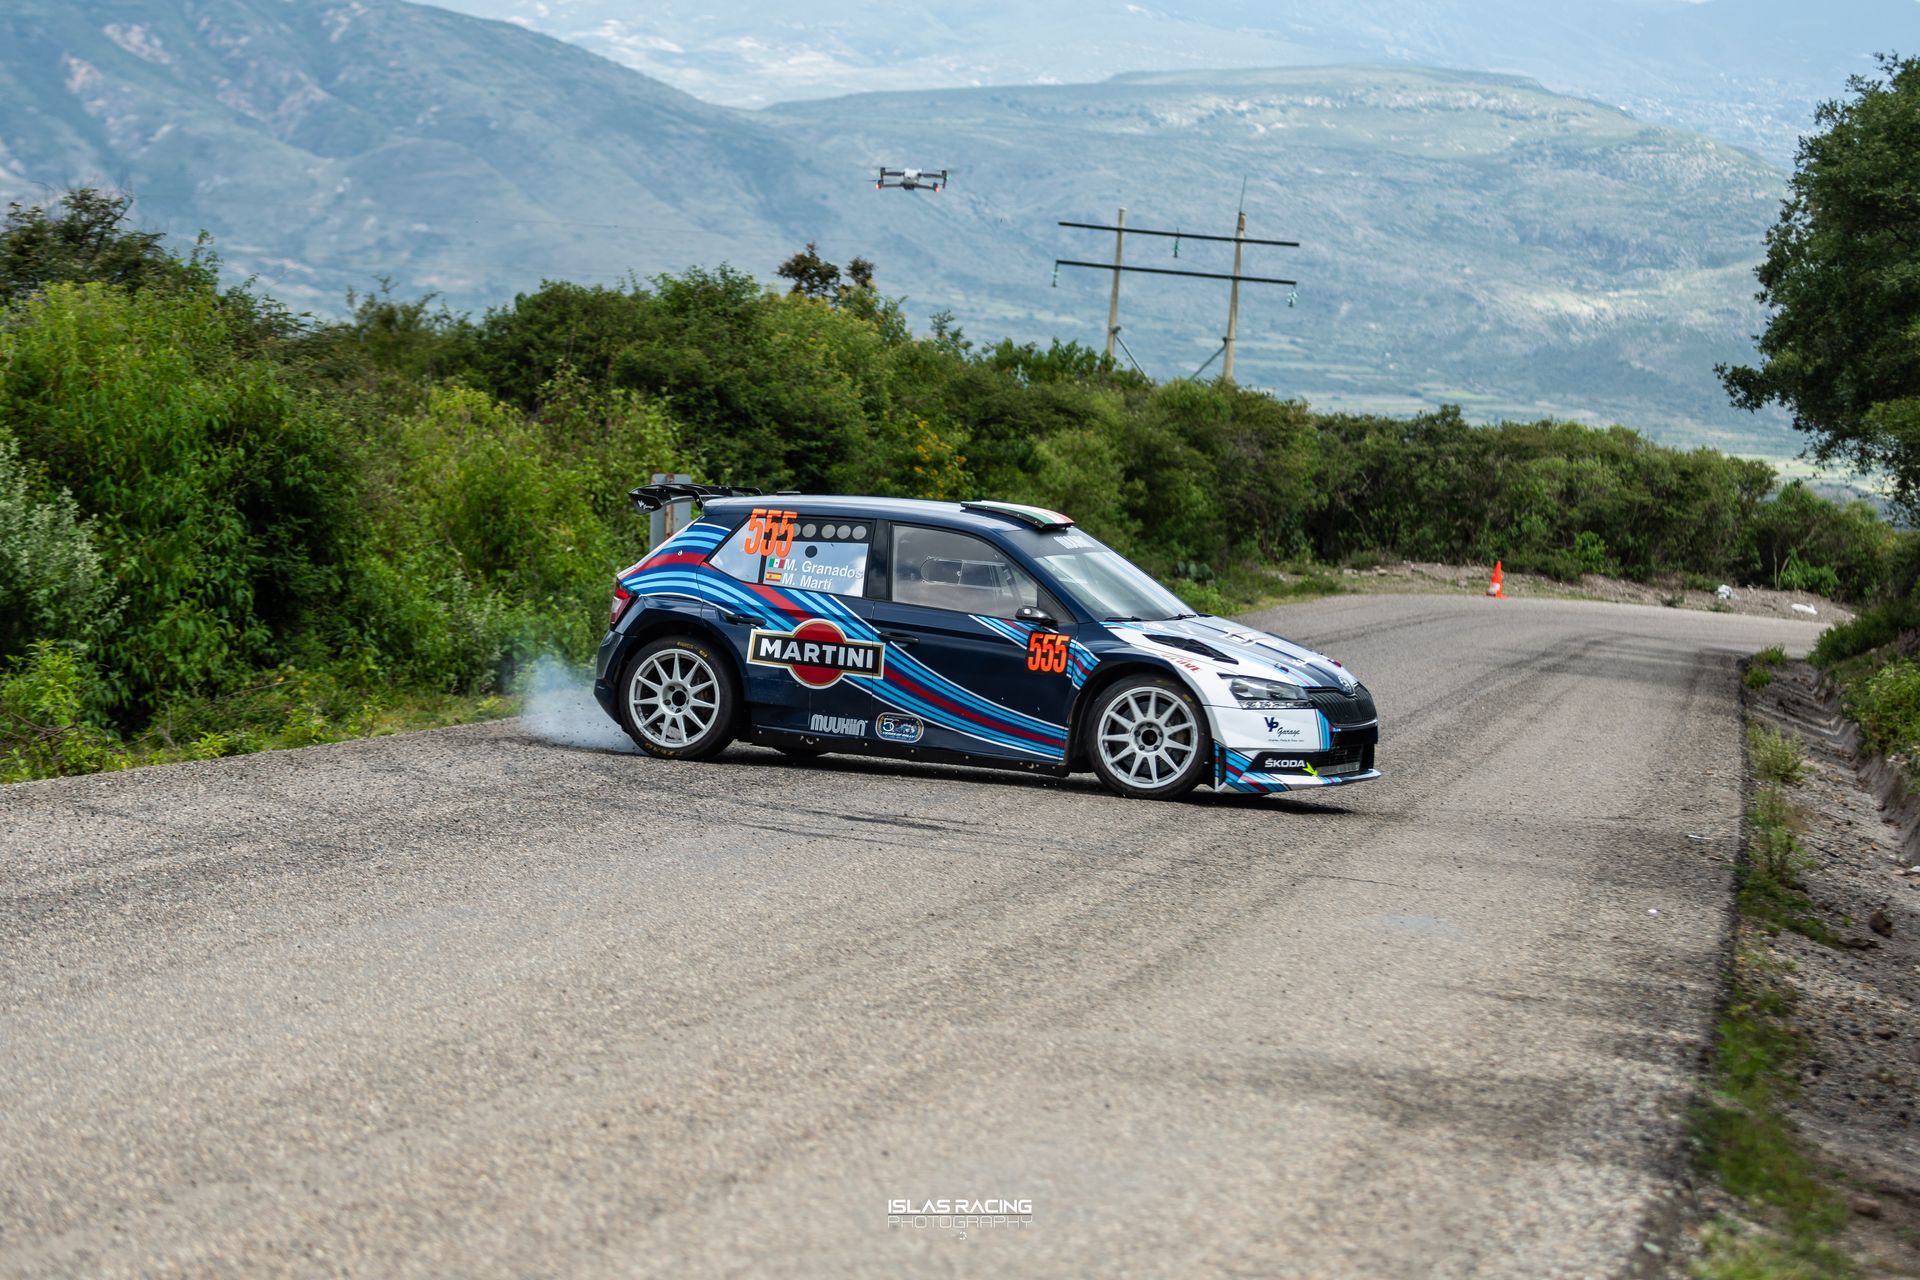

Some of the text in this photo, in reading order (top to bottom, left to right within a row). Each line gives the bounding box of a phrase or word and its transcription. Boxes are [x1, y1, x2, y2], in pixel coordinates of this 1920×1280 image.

[744, 508, 798, 558] 555
[781, 573, 796, 586] M.
[783, 559, 865, 579] M. Granados
[759, 638, 874, 669] MARTINI
[1027, 632, 1070, 674] 555
[1264, 757, 1306, 769] ŠKODA
